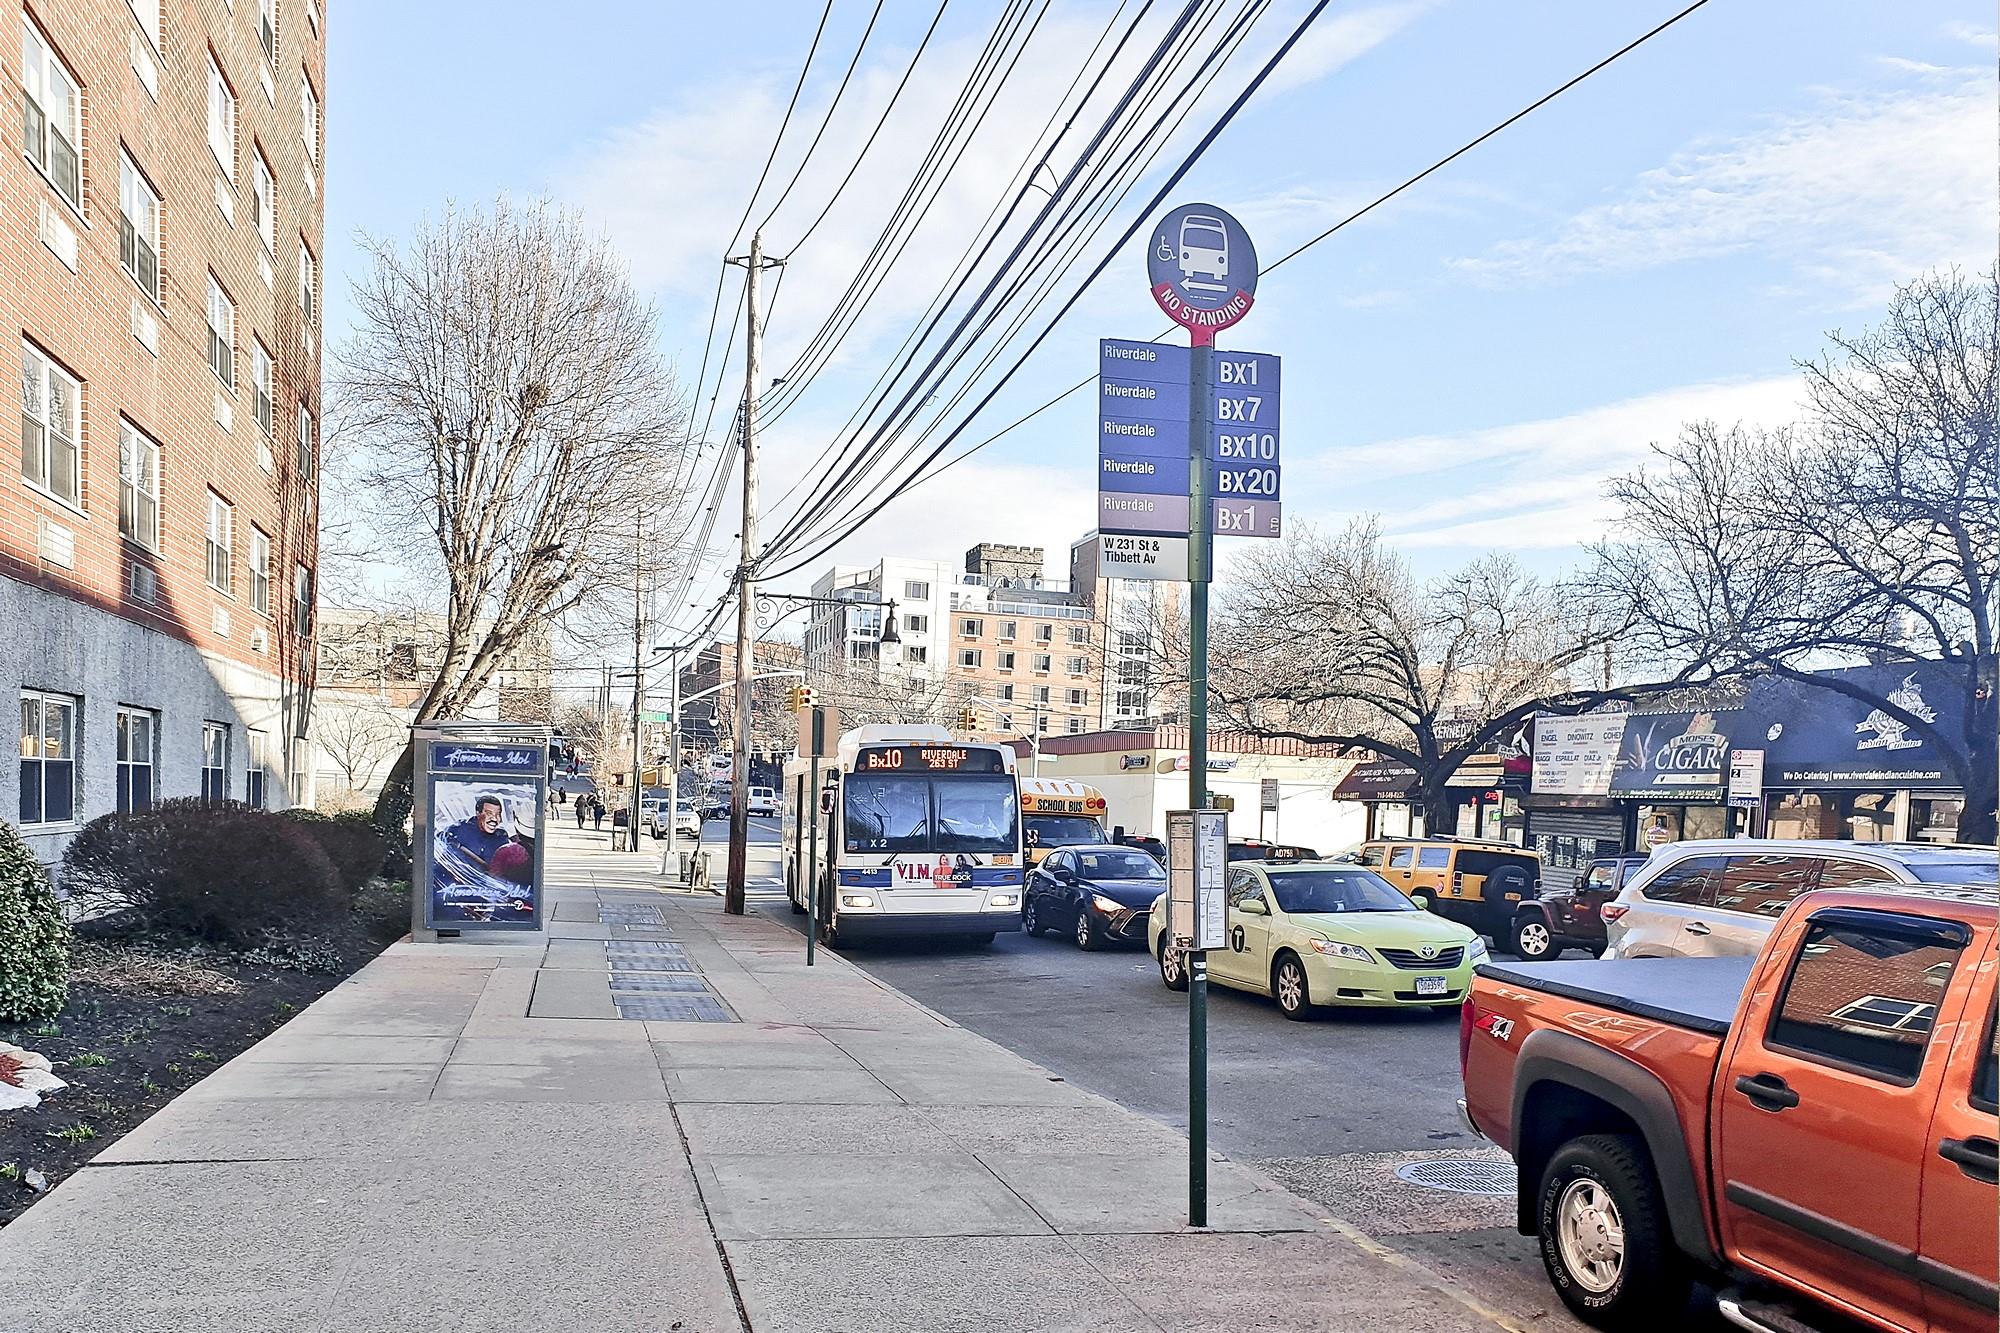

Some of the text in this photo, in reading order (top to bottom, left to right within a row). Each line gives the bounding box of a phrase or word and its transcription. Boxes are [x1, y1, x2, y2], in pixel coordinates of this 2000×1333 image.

[1160, 287, 1247, 326] NO STANDING
[1104, 345, 1156, 362] Riverdale
[1220, 360, 1258, 385] BX1
[1104, 383, 1156, 400] Riverdale
[1218, 396, 1262, 422] BX7
[1104, 421, 1155, 437] Riverdale
[1219, 433, 1276, 460] BX10
[1103, 459, 1155, 475] Riverdale
[1218, 468, 1277, 495] BX20
[1103, 497, 1154, 512] Riverdale
[1217, 505, 1255, 531] Bx1
[1270, 517, 1279, 533] LTD
[1104, 537, 1160, 551] W 231 St &
[1105, 551, 1156, 564] Tibbett Av
[1679, 735, 1715, 744] MOISES
[444, 748, 530, 768] American Idol
[869, 749, 902, 768] Bx10
[921, 749, 967, 760] RIVERDALE
[929, 759, 959, 768] 263 ST
[1783, 771, 1793, 780] We
[1793, 771, 1802, 780] Do
[1803, 771, 1828, 782] Catering
[1037, 799, 1083, 812] SCHOOL BUS
[870, 839, 887, 848] X 2
[896, 863, 932, 880] V.I.M.
[501, 884, 531, 899] Idol
